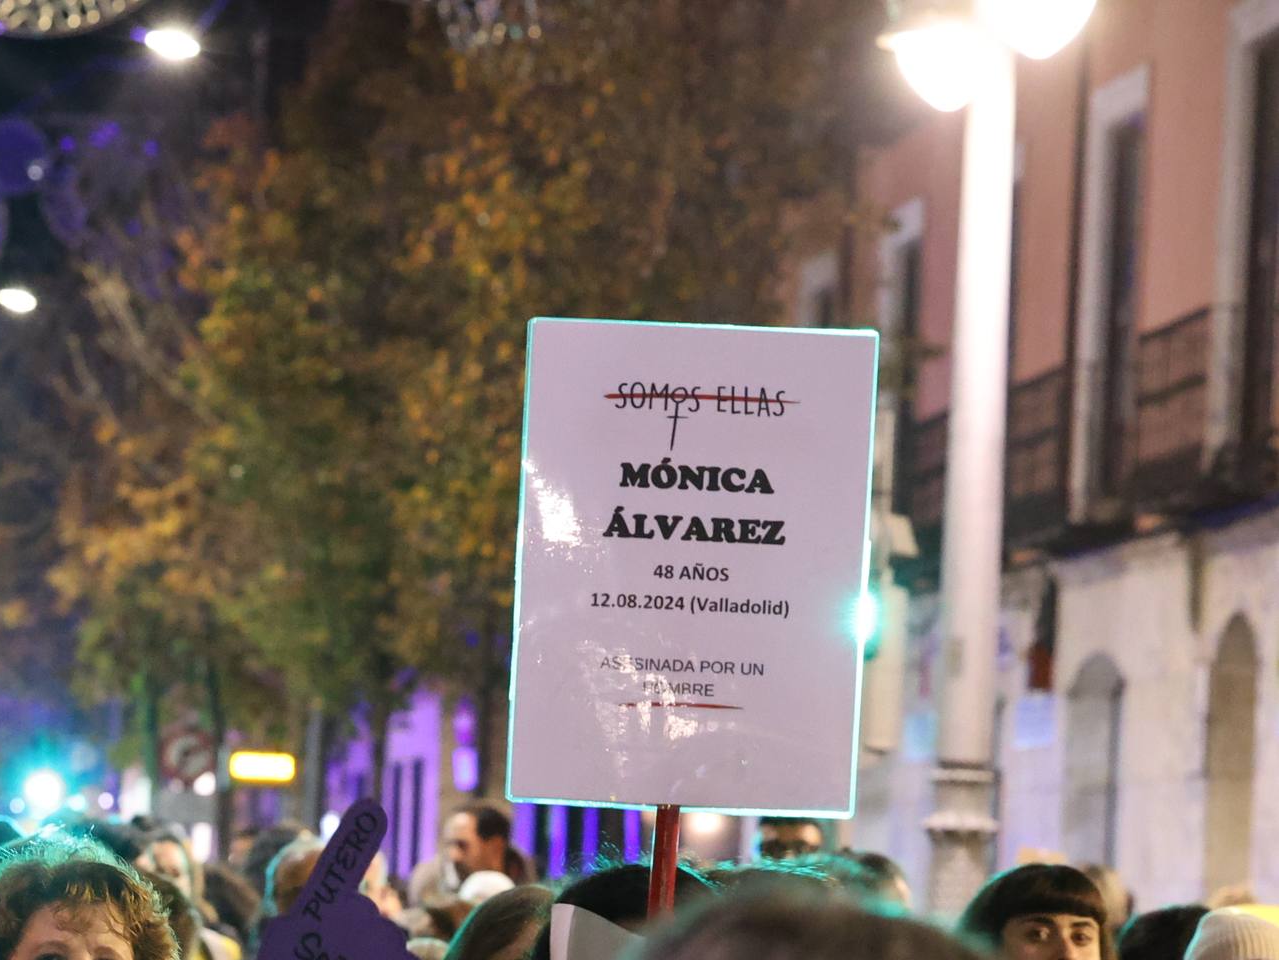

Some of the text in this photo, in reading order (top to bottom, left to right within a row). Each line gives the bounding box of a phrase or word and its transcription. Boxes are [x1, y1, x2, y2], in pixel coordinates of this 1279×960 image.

[614, 382, 787, 418] SOMOS ELLAS
[619, 457, 775, 495] MÓNICA
[602, 506, 787, 546] ÁLVAREZ
[653, 562, 730, 582] 48 AÑOS
[590, 592, 791, 619] 12.08.2024 (Valladolid)
[700, 660, 736, 674] POR
[740, 663, 765, 676] UN
[301, 809, 379, 924] PUTERO
